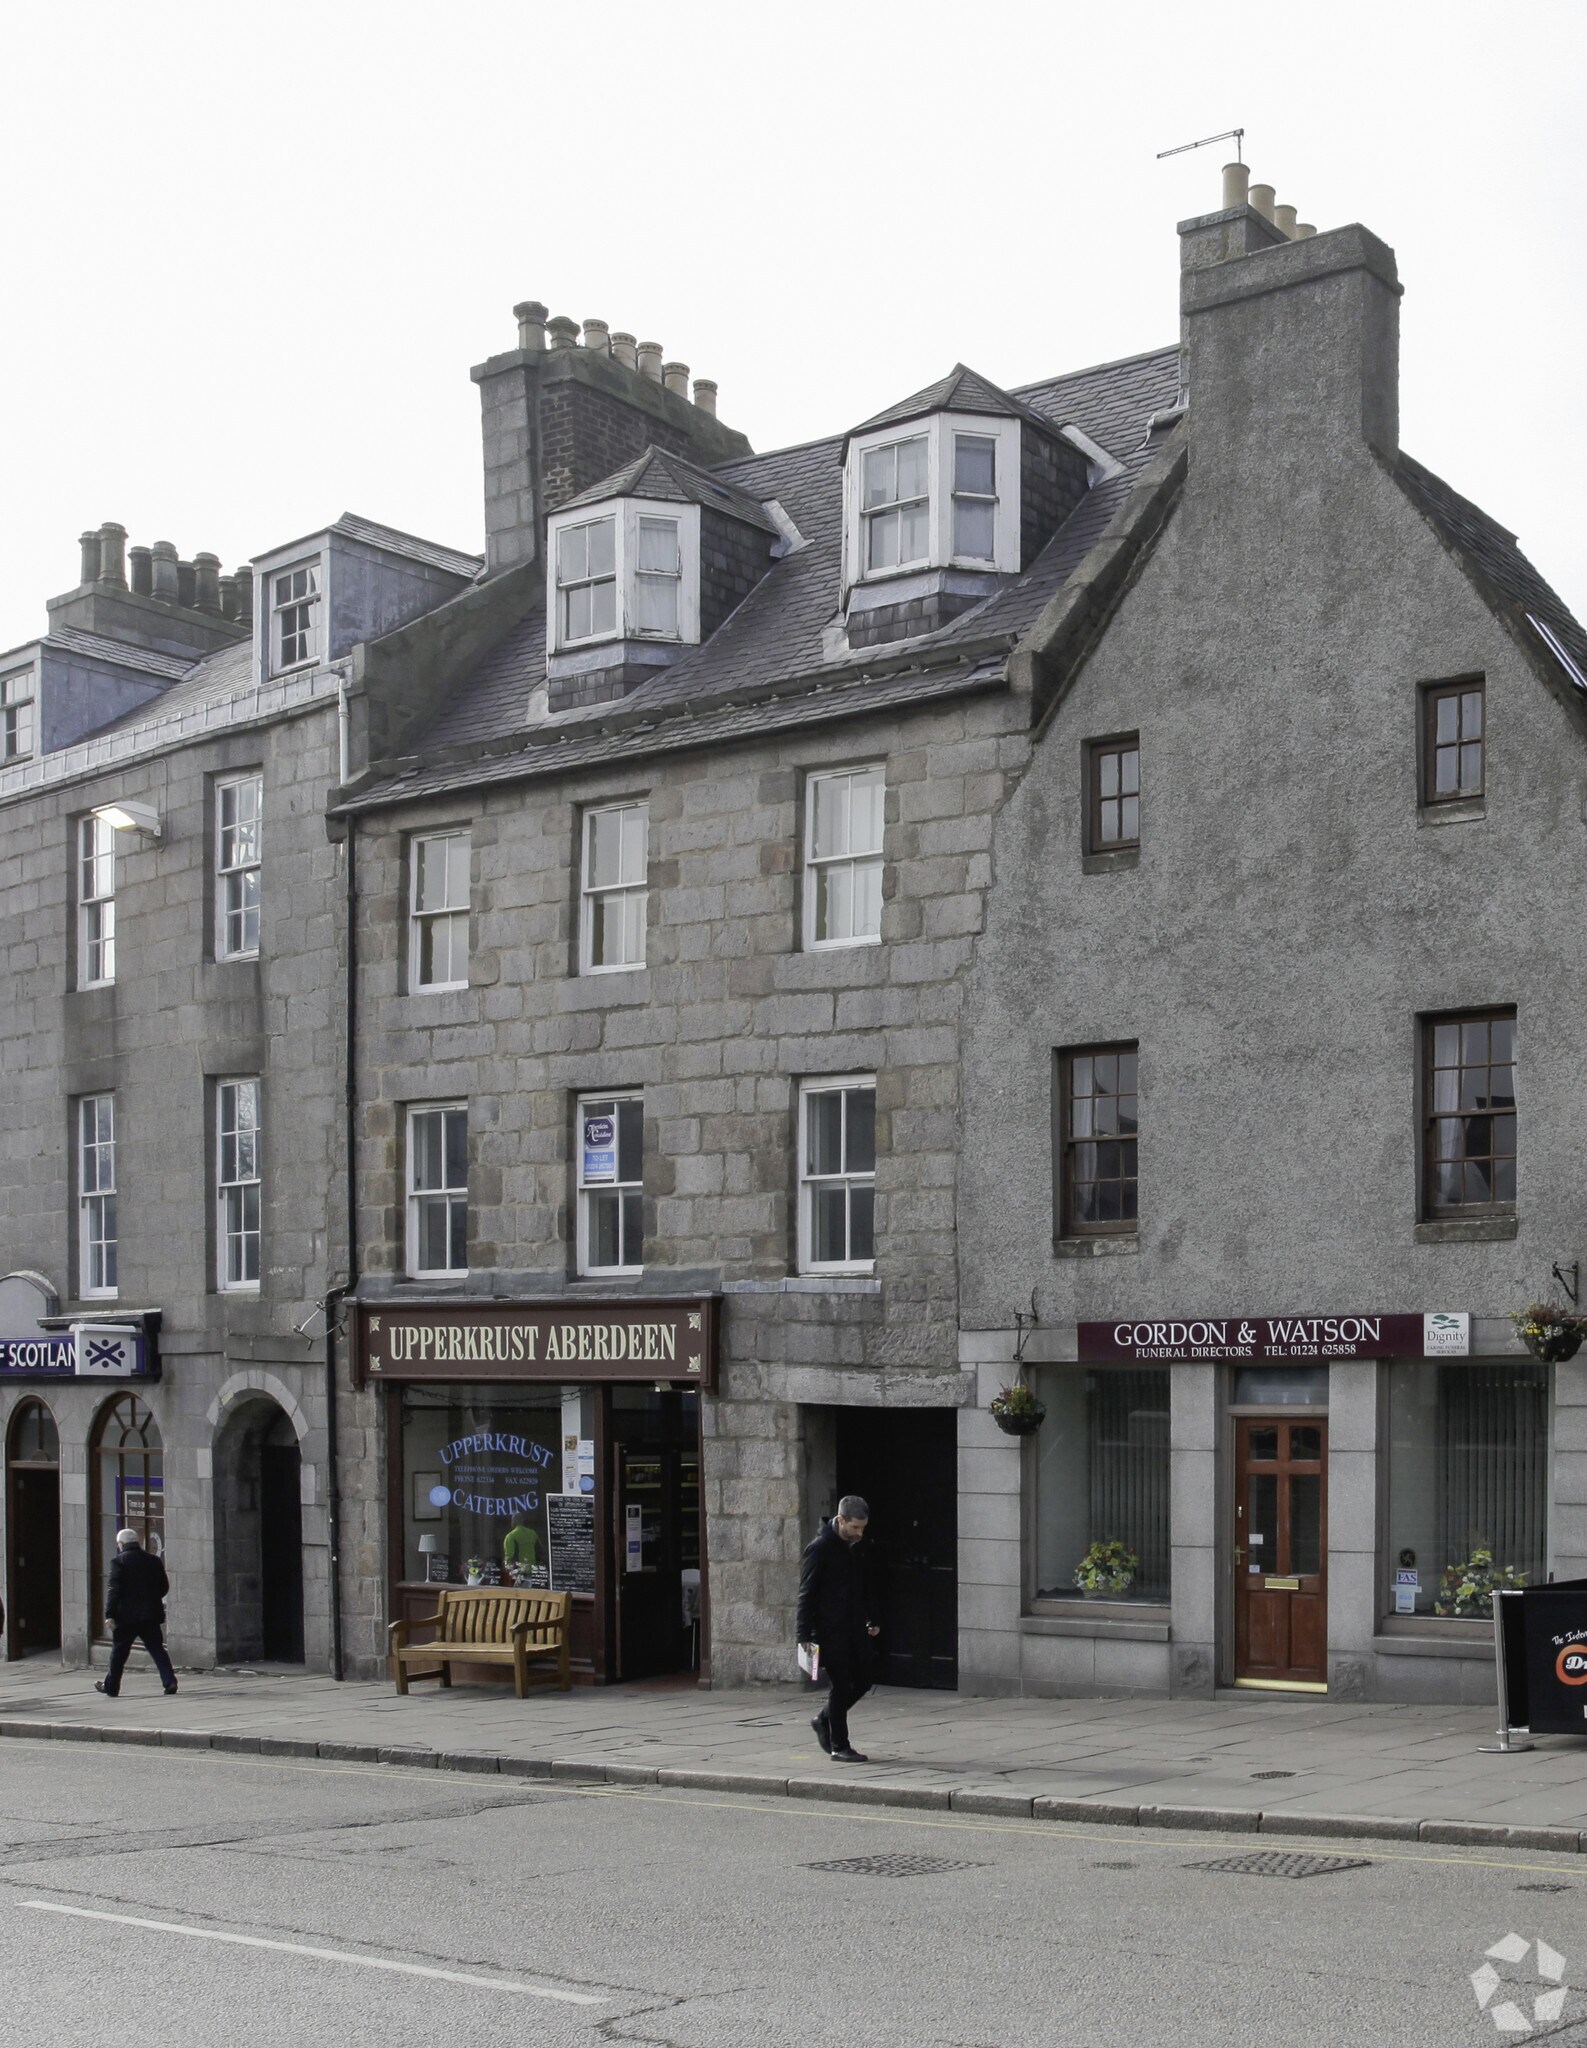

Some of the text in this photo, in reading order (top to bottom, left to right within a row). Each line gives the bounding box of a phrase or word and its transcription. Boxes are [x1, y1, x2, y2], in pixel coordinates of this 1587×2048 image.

[389, 1323, 677, 1361] UPPERKRUST ABERDEEN
[1114, 1318, 1382, 1346] GORDON & WATSON
[1427, 1330, 1466, 1345] Dignity
[8, 1342, 77, 1367] SCOTLAN
[1135, 1347, 1188, 1358] FUNERAL
[1264, 1345, 1288, 1356] TEL:
[1290, 1345, 1318, 1356] 01224
[1321, 1343, 1357, 1355] 625858
[438, 1432, 554, 1469] UPPERKRUST
[505, 1476, 518, 1484] FAX
[452, 1488, 539, 1516] CATERING
[1551, 1635, 1564, 1646] The
